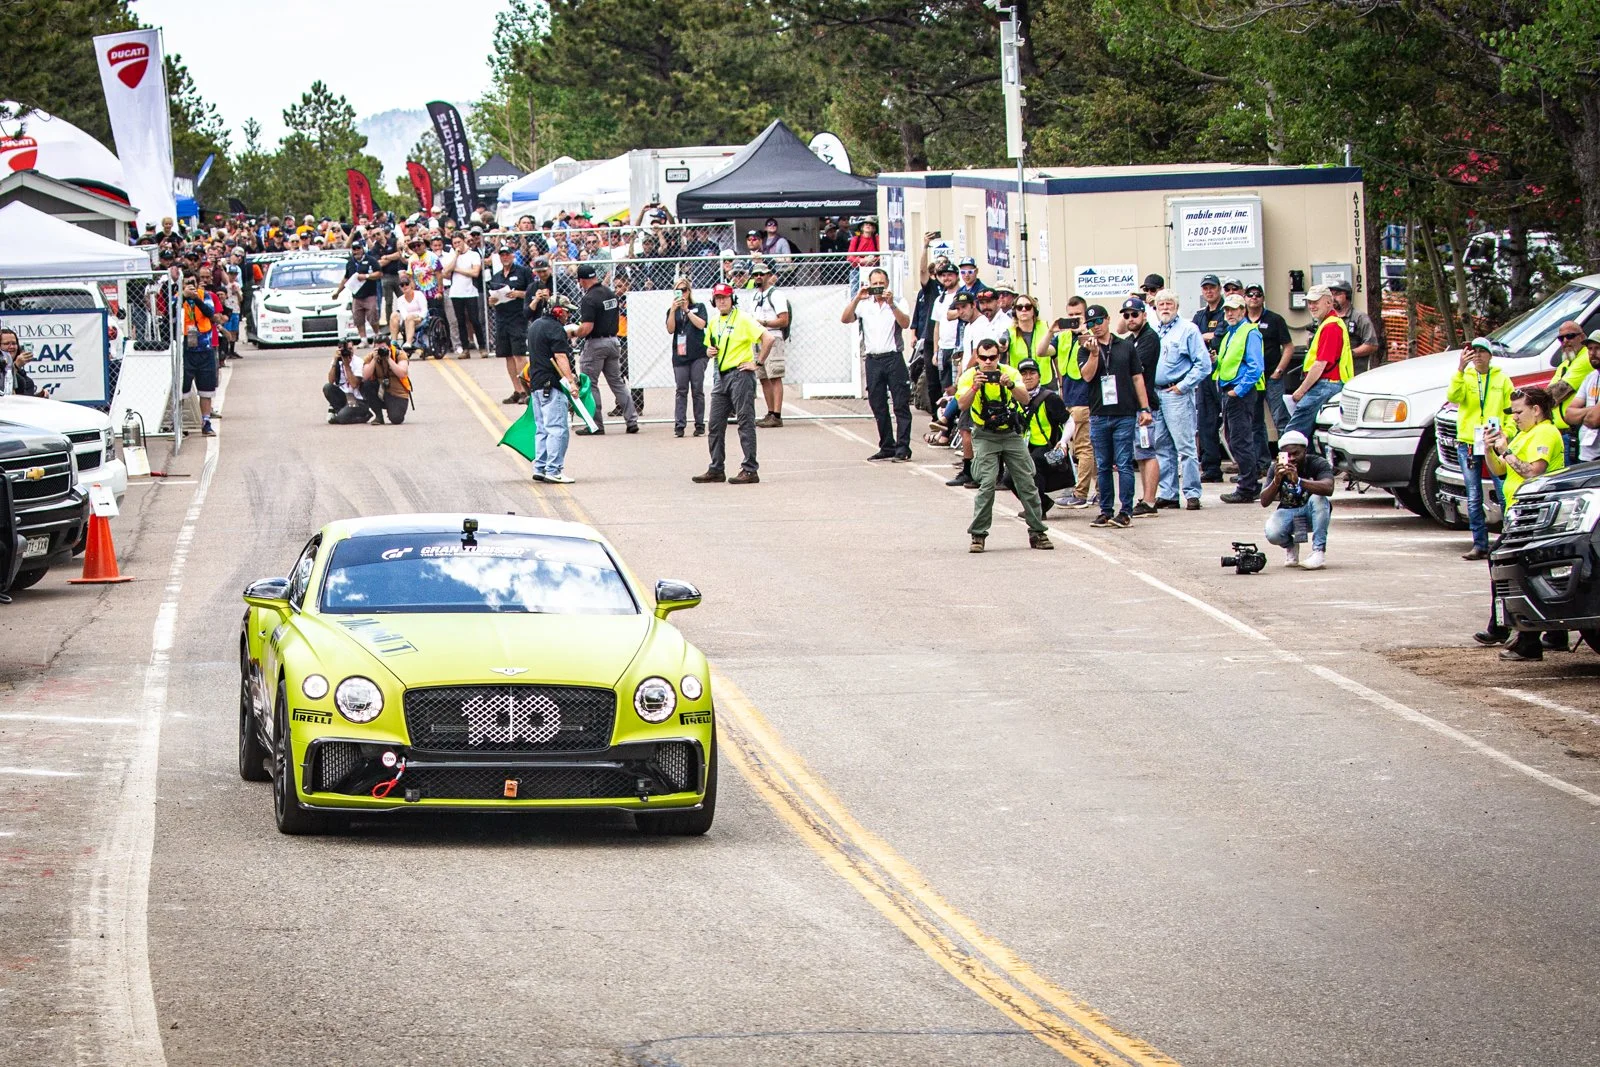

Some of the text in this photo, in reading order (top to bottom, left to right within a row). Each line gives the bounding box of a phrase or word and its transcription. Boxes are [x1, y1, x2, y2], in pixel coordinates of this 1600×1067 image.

[110, 47, 146, 60] DUCATI
[457, 142, 466, 162] Jeep
[1185, 209, 1213, 220] mobile
[1234, 209, 1249, 218] inc.
[1187, 225, 1248, 236] 1-800-950-MINI
[1078, 275, 1134, 284] PIKES PEAK
[12, 323, 74, 338] ADMOOR
[32, 343, 74, 362] AK
[38, 364, 75, 373] CLIMB
[420, 546, 462, 555] GRAN
[292, 708, 333, 725] PIRELLI
[461, 695, 561, 746] 100
